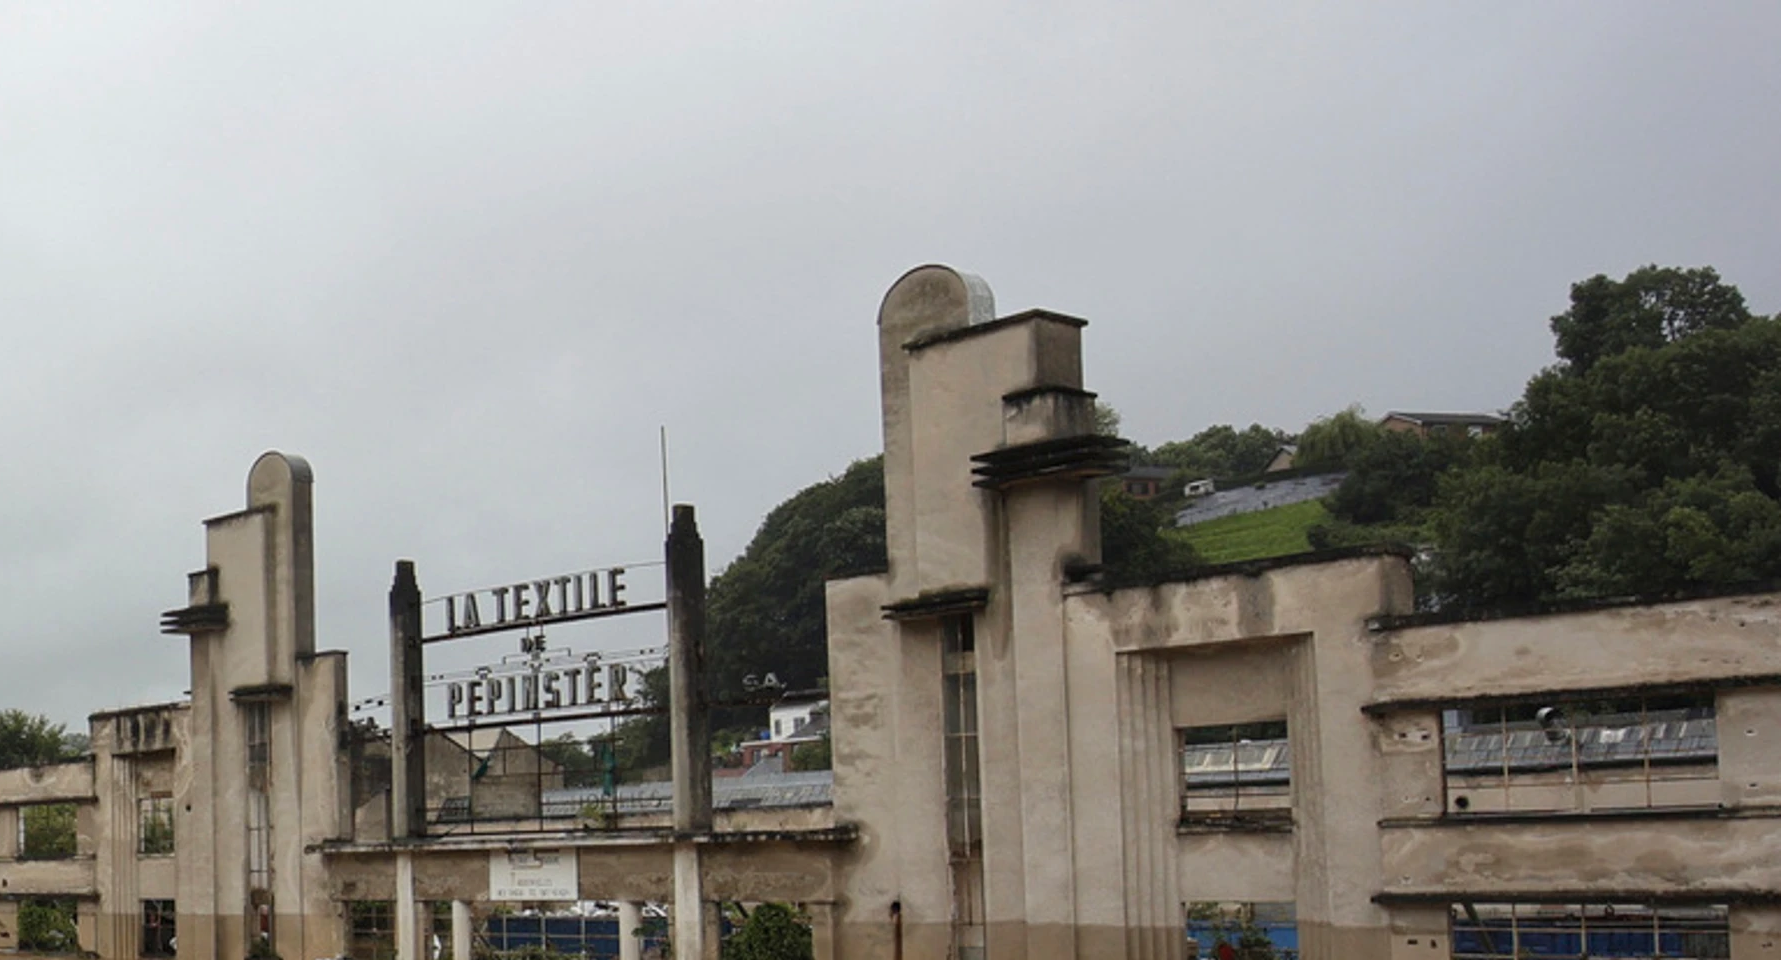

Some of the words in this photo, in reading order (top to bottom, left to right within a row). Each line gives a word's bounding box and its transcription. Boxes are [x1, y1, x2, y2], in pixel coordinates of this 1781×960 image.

[446, 594, 481, 632] LA
[491, 567, 627, 624] TEXTILE
[521, 635, 546, 652] DE
[447, 664, 632, 719] PEPINSTER
